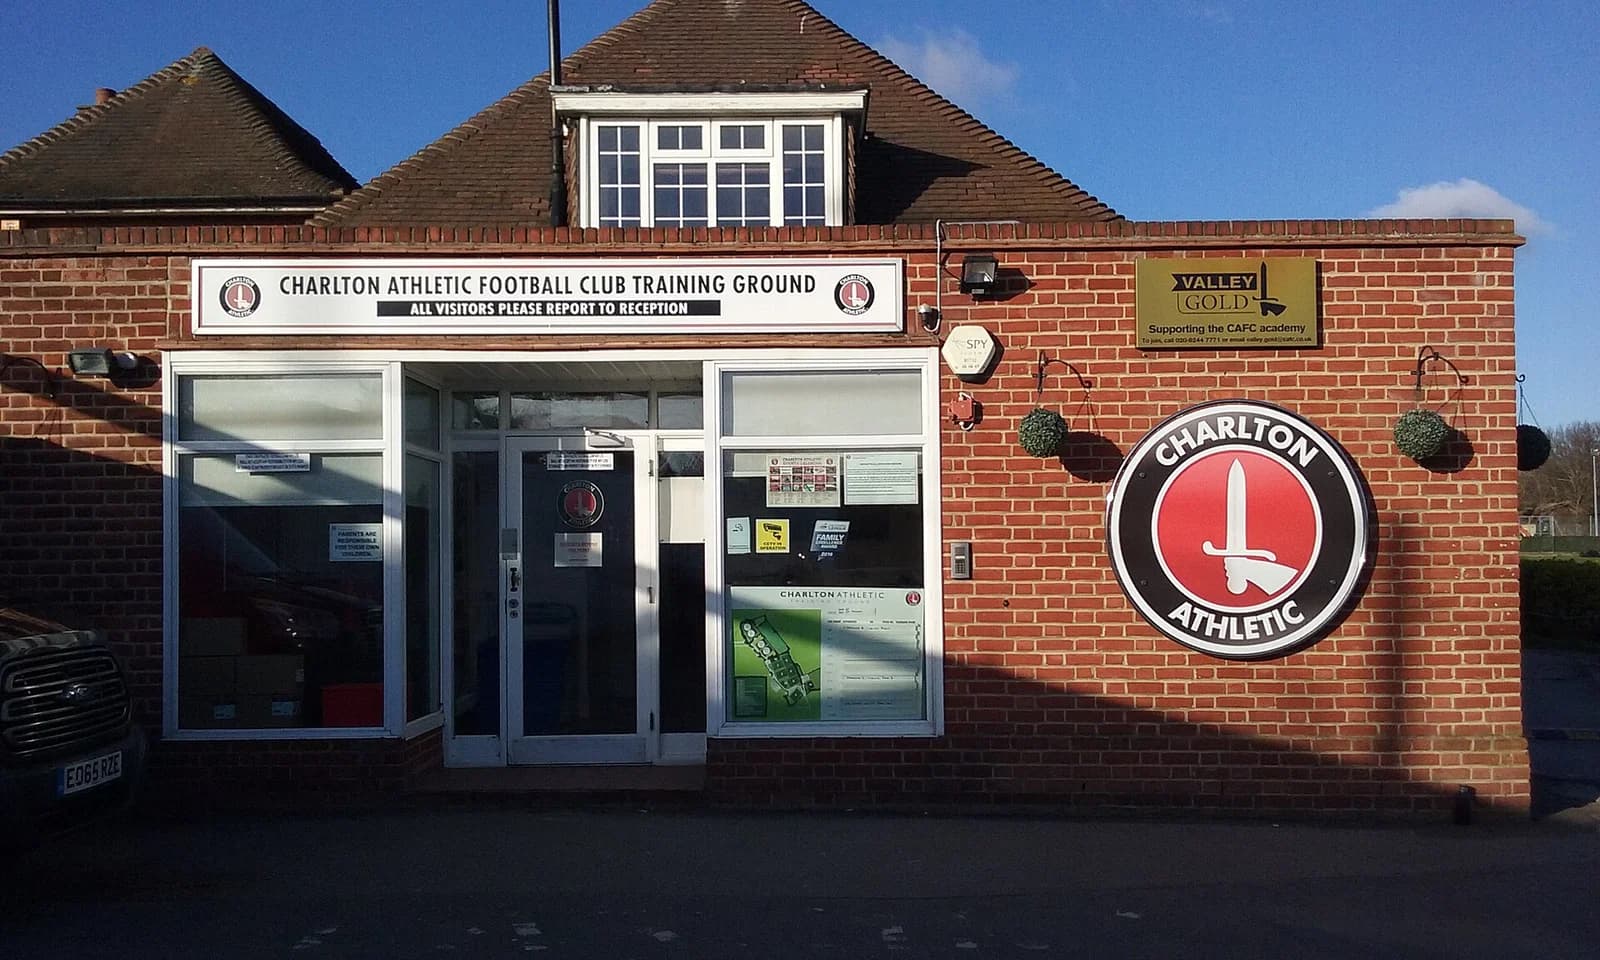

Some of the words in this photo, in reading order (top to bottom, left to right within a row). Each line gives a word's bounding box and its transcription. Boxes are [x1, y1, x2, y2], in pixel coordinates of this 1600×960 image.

[280, 275, 380, 296] CHARLTON
[387, 275, 473, 296] ATHLETIC
[479, 275, 573, 295] FOOTBALL
[579, 275, 627, 295] CLUB
[632, 274, 726, 295] TRAINING
[732, 274, 817, 294] GROUND
[1181, 276, 1255, 289] VALLEY
[410, 302, 434, 315] ALL
[435, 302, 495, 315] VISITORS
[497, 302, 543, 315] PLEASE
[546, 302, 598, 315] REPORT
[599, 302, 617, 315] TO
[619, 302, 688, 315] RECEPTION
[1185, 294, 1249, 310] GOLD
[1148, 325, 1205, 335] Supporting
[1208, 325, 1224, 333] the
[1227, 324, 1257, 333] CAFC
[1259, 324, 1306, 334] academy
[966, 339, 988, 350] SPY
[1155, 415, 1320, 468] CHARLTON
[816, 533, 845, 541] FAMILY
[836, 591, 885, 599] ATHLETIC
[1167, 600, 1305, 641] ATHLETIC
[66, 761, 99, 789] EO65
[101, 754, 120, 778] RZE
